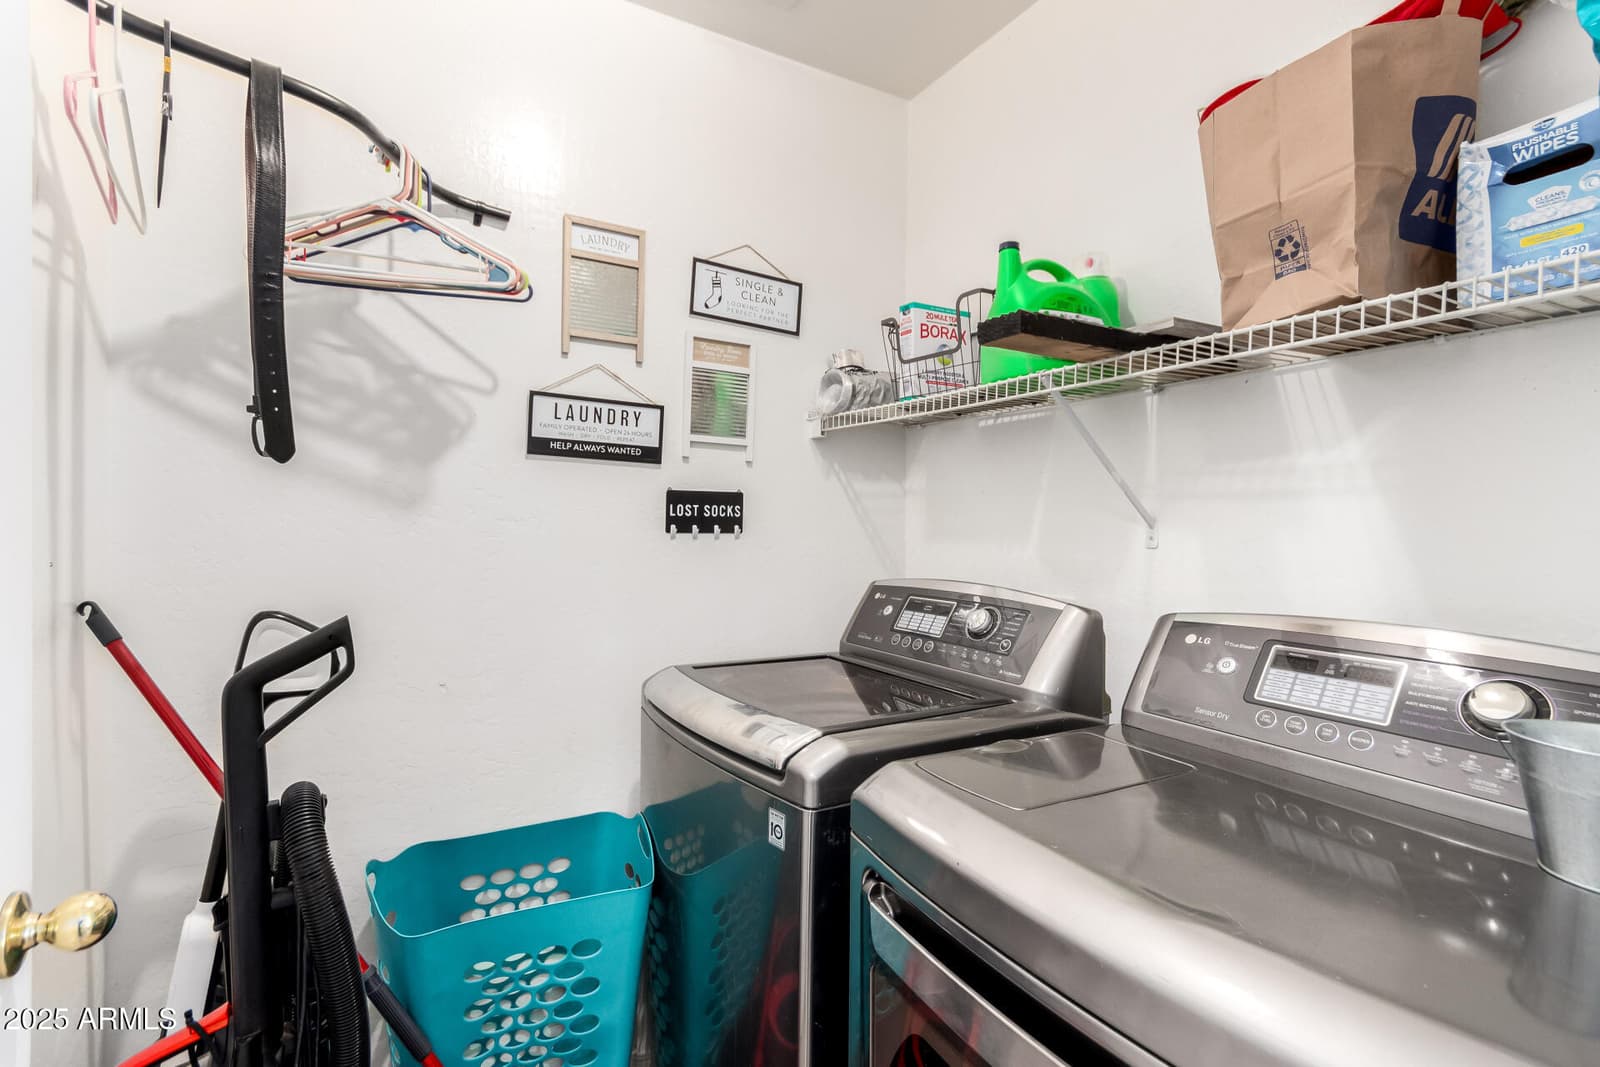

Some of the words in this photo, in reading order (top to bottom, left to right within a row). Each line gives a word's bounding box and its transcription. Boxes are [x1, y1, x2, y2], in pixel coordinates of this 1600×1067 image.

[1512, 121, 1579, 152] FLUSHABLE
[1512, 130, 1580, 163] WIPES
[581, 233, 631, 252] LAUNDRY
[1562, 244, 1586, 256] 420
[735, 276, 774, 295] SINGLE
[777, 287, 784, 297] &
[741, 290, 777, 306] CLEAN
[920, 323, 967, 346] BORAX
[554, 402, 641, 427] LAUNDRY
[563, 424, 598, 434] OPERATED
[604, 428, 622, 436] OPEN
[631, 431, 653, 439] HOURS
[550, 441, 572, 450] HELP
[573, 442, 606, 453] ALWAYS
[607, 445, 642, 456] WANTED
[669, 504, 699, 517] LOST
[703, 504, 741, 518] SOCKS
[1198, 636, 1211, 645] LG
[1194, 706, 1217, 717] Sensor
[1217, 711, 1231, 721] Dry
